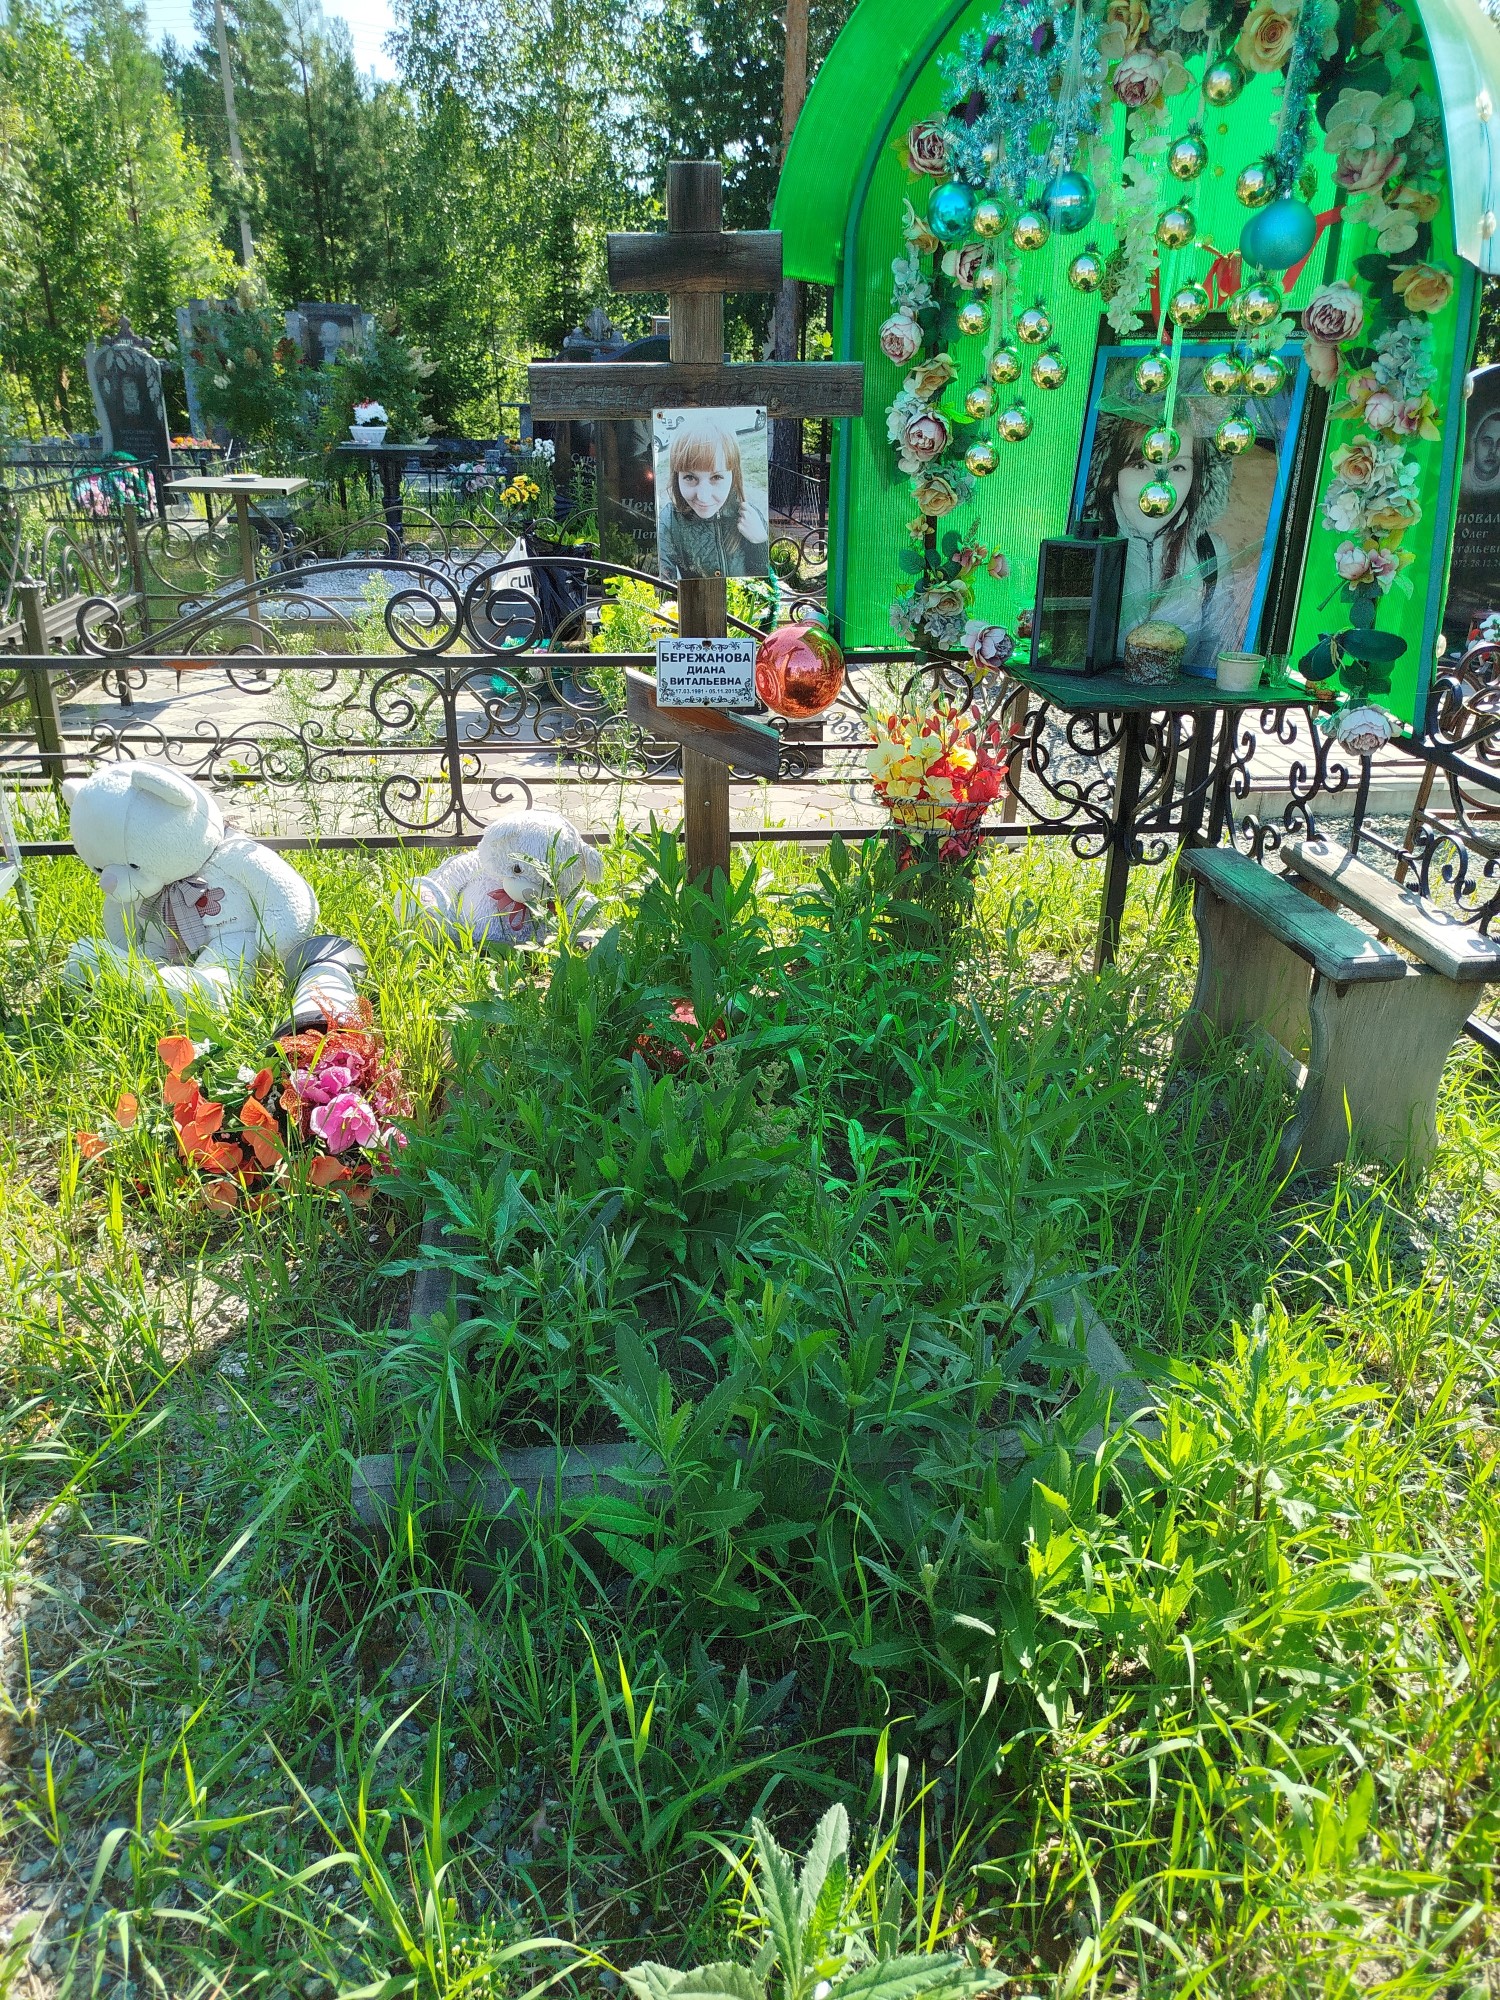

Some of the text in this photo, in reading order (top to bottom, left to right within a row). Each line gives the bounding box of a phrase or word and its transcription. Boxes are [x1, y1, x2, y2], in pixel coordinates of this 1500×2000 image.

[661, 652, 751, 663] БЕРЕЖАНОВА
[686, 666, 726, 675] ДИАНА
[669, 677, 742, 686] ВИТАЛЬЕВНА
